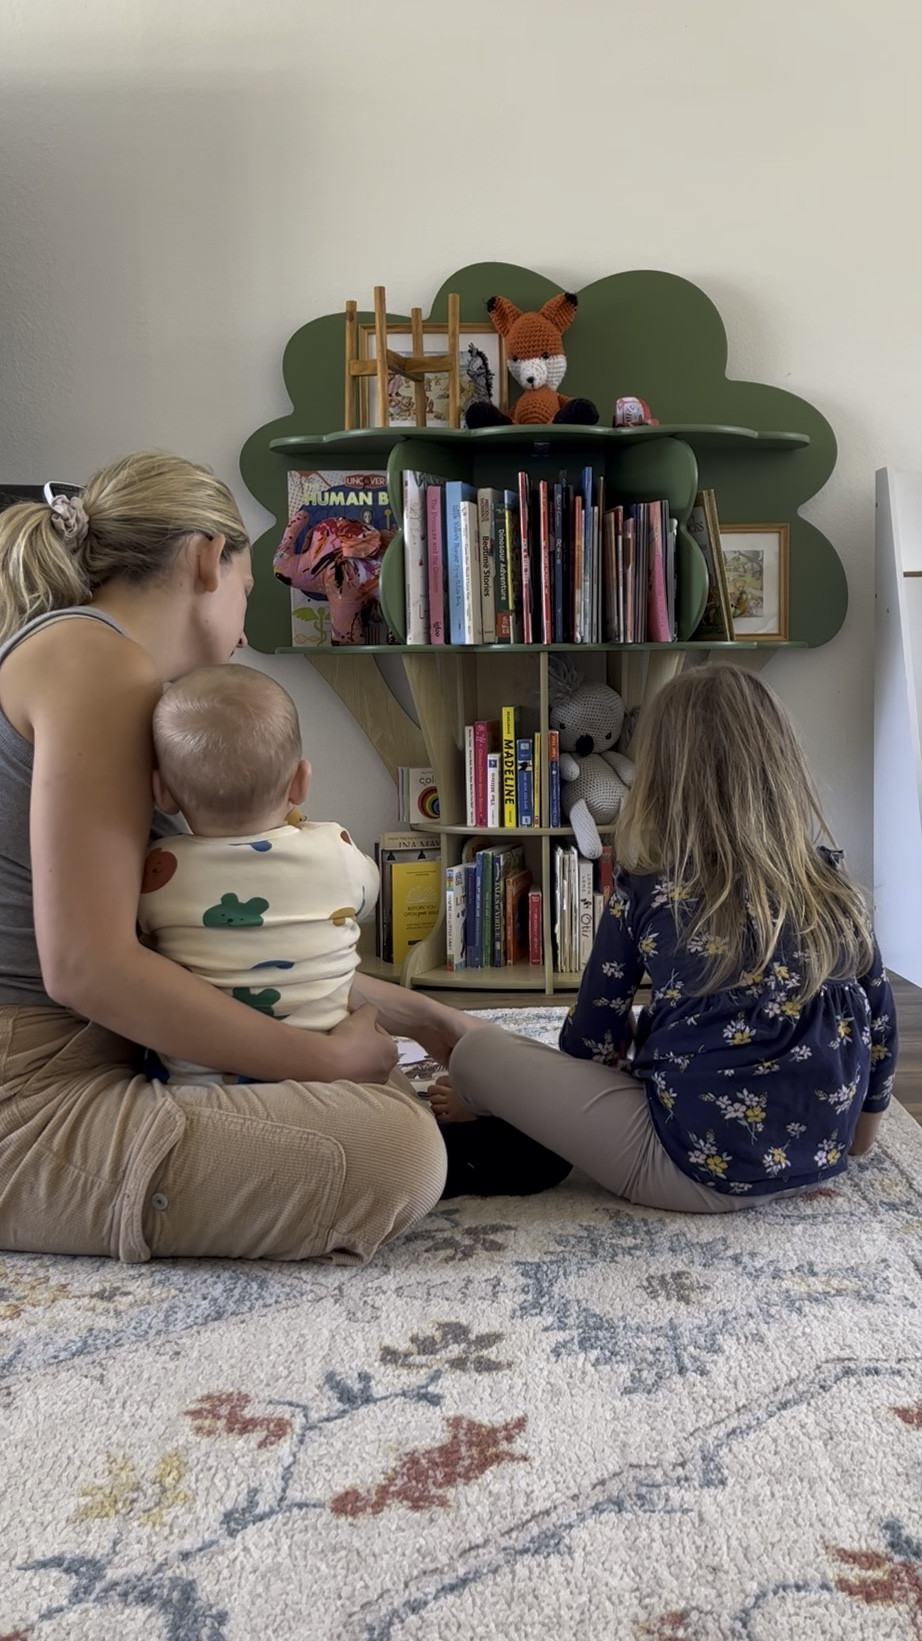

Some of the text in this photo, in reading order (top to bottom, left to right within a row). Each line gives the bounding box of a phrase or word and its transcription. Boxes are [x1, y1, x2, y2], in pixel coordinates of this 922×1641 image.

[304, 491, 374, 506] HUMAN
[433, 621, 442, 637] igloo
[419, 775, 435, 785] col
[504, 739, 515, 805] MADELINE
[581, 913, 593, 938] Otis
